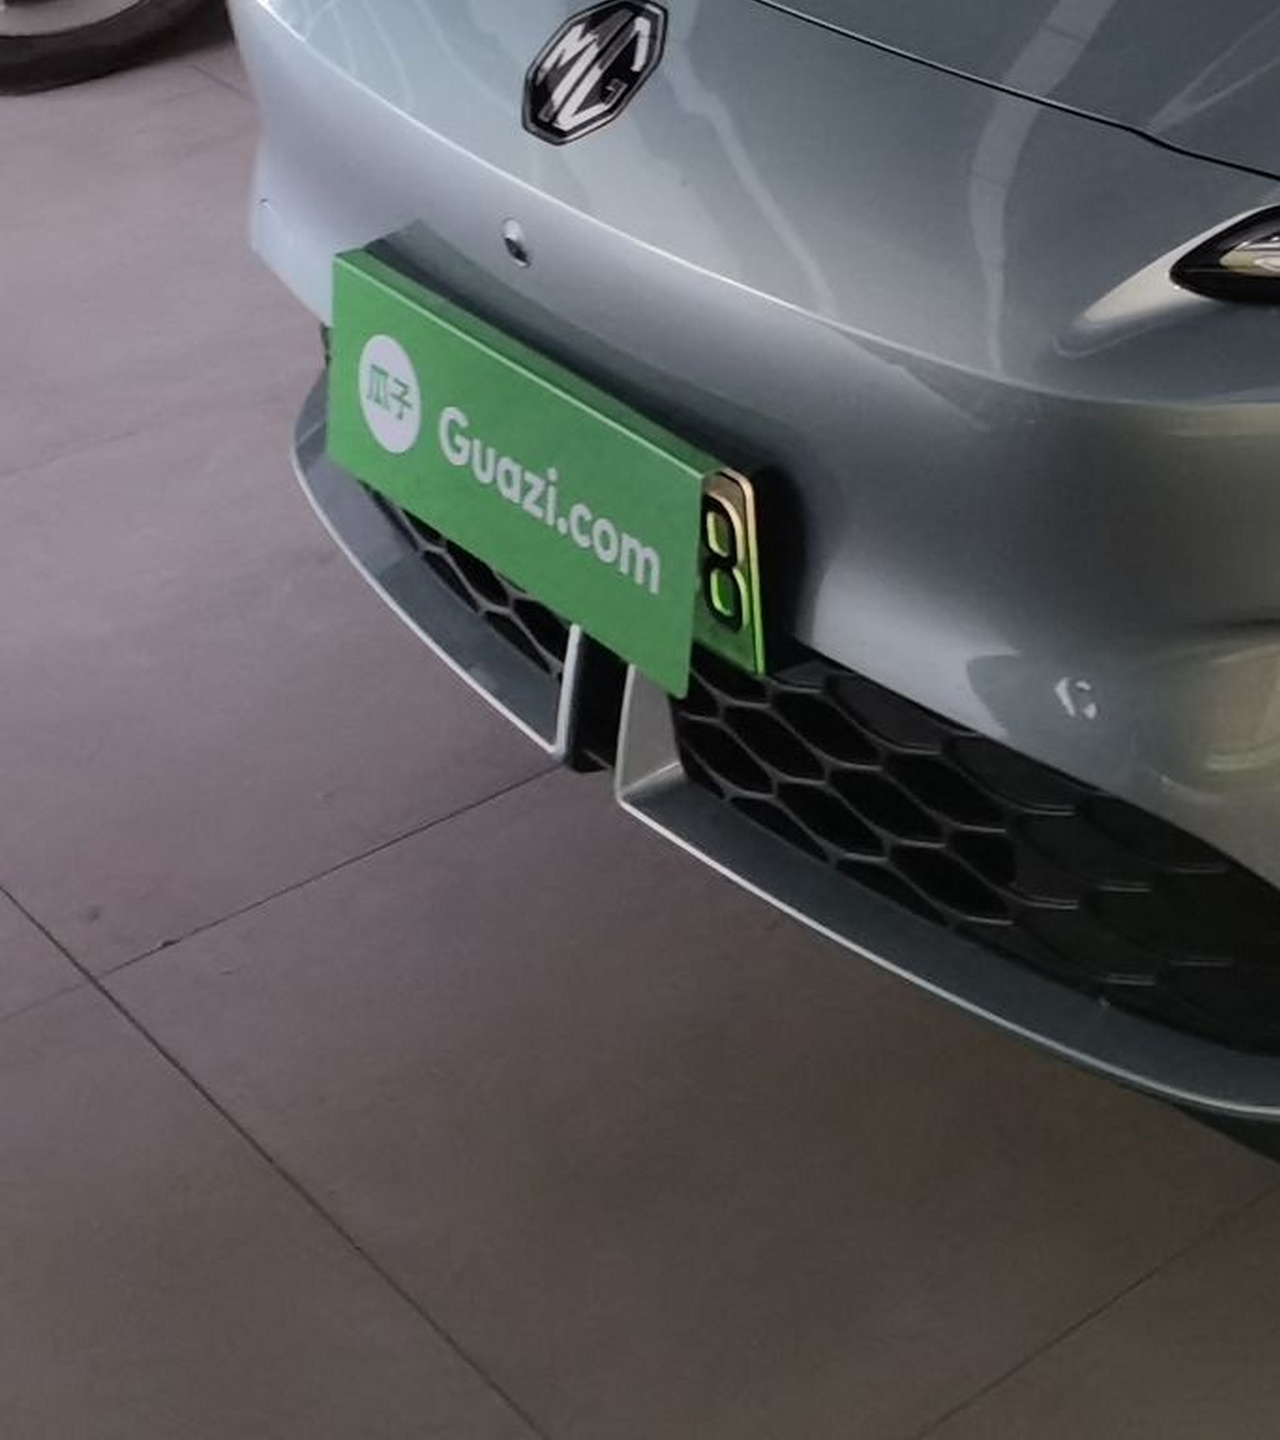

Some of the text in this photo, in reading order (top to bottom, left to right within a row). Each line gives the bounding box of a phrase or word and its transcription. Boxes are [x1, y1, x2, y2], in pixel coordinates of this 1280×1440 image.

[534, 7, 653, 133] MG
[366, 363, 413, 422] 瓜子
[438, 406, 661, 595] Guazi.com
